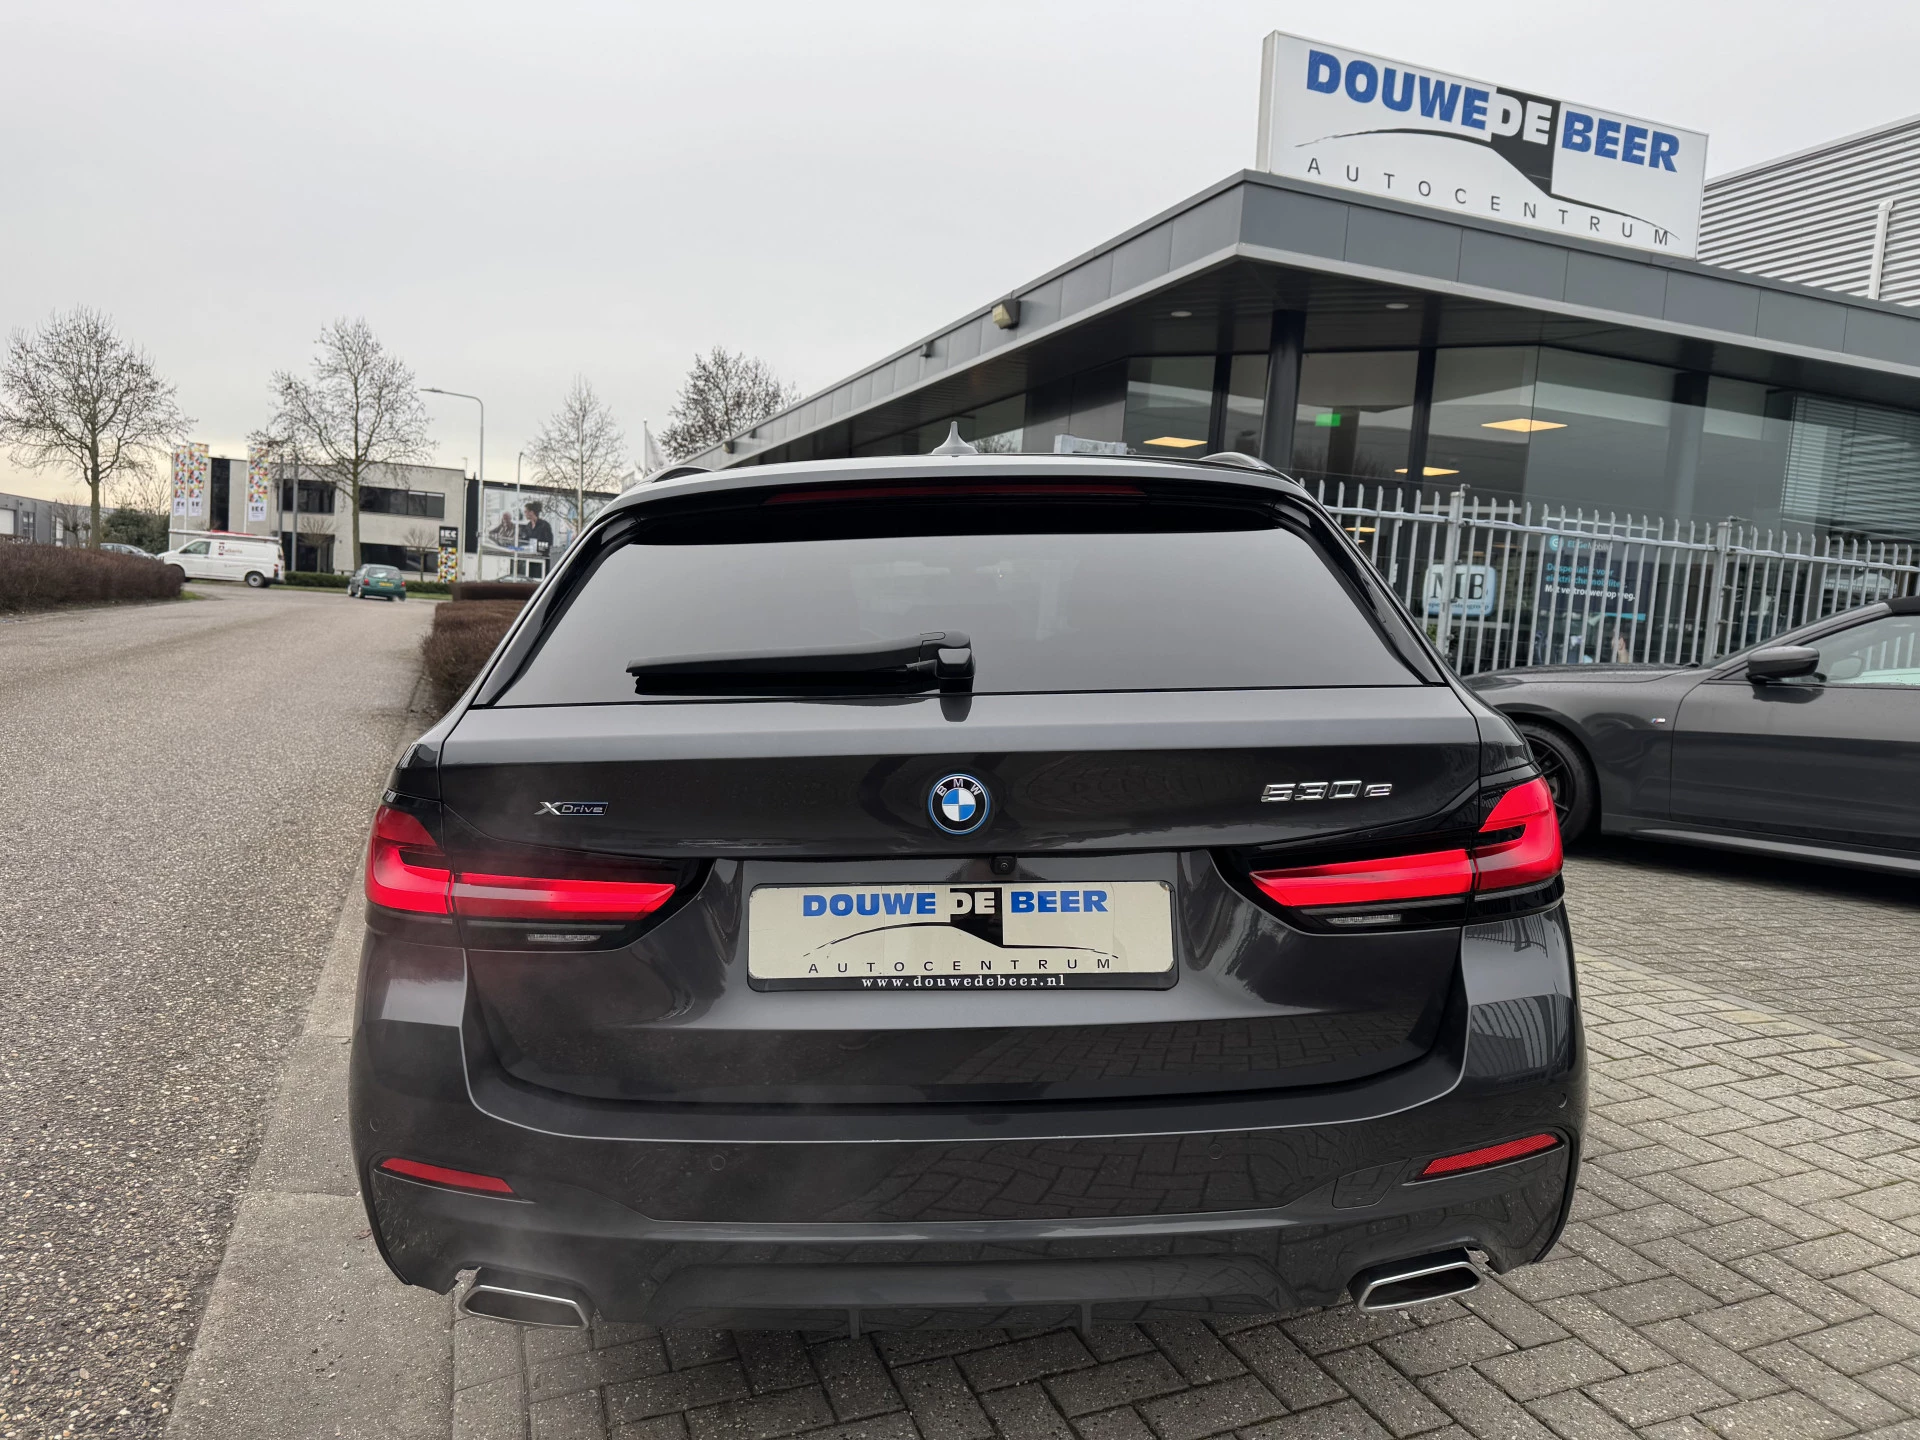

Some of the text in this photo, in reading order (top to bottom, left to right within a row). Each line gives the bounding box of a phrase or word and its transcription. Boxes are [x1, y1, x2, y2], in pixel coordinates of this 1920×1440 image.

[1307, 49, 1680, 173] DOUWE DE BEER
[1307, 157, 1668, 246] AUTOCENTRUM
[936, 778, 981, 797] BMW
[803, 890, 1108, 916] DOUWE DE BEER
[808, 958, 1110, 975] AUTOCENTRUM
[862, 975, 1066, 988] www.douwedebeer.nl
